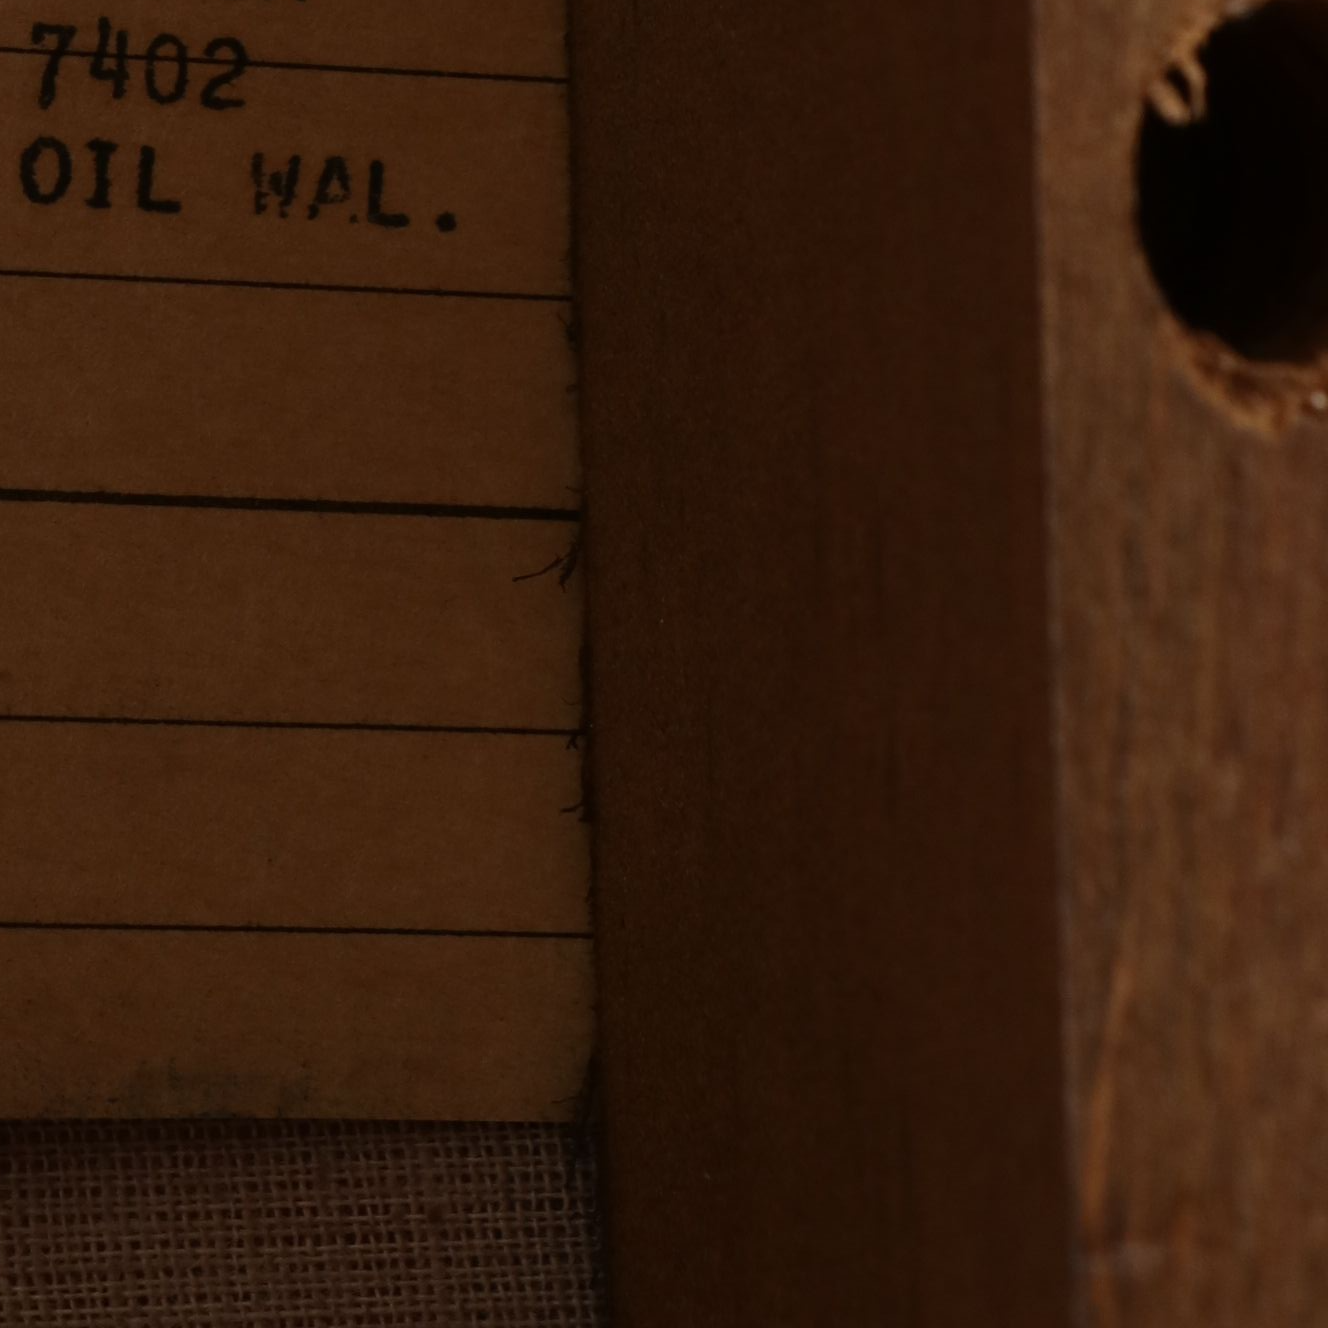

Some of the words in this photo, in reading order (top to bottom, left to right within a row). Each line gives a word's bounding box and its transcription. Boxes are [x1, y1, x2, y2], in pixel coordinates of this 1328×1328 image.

[32, 17, 251, 110] 7402
[20, 136, 182, 214] OIL
[251, 152, 457, 233] WAL.
